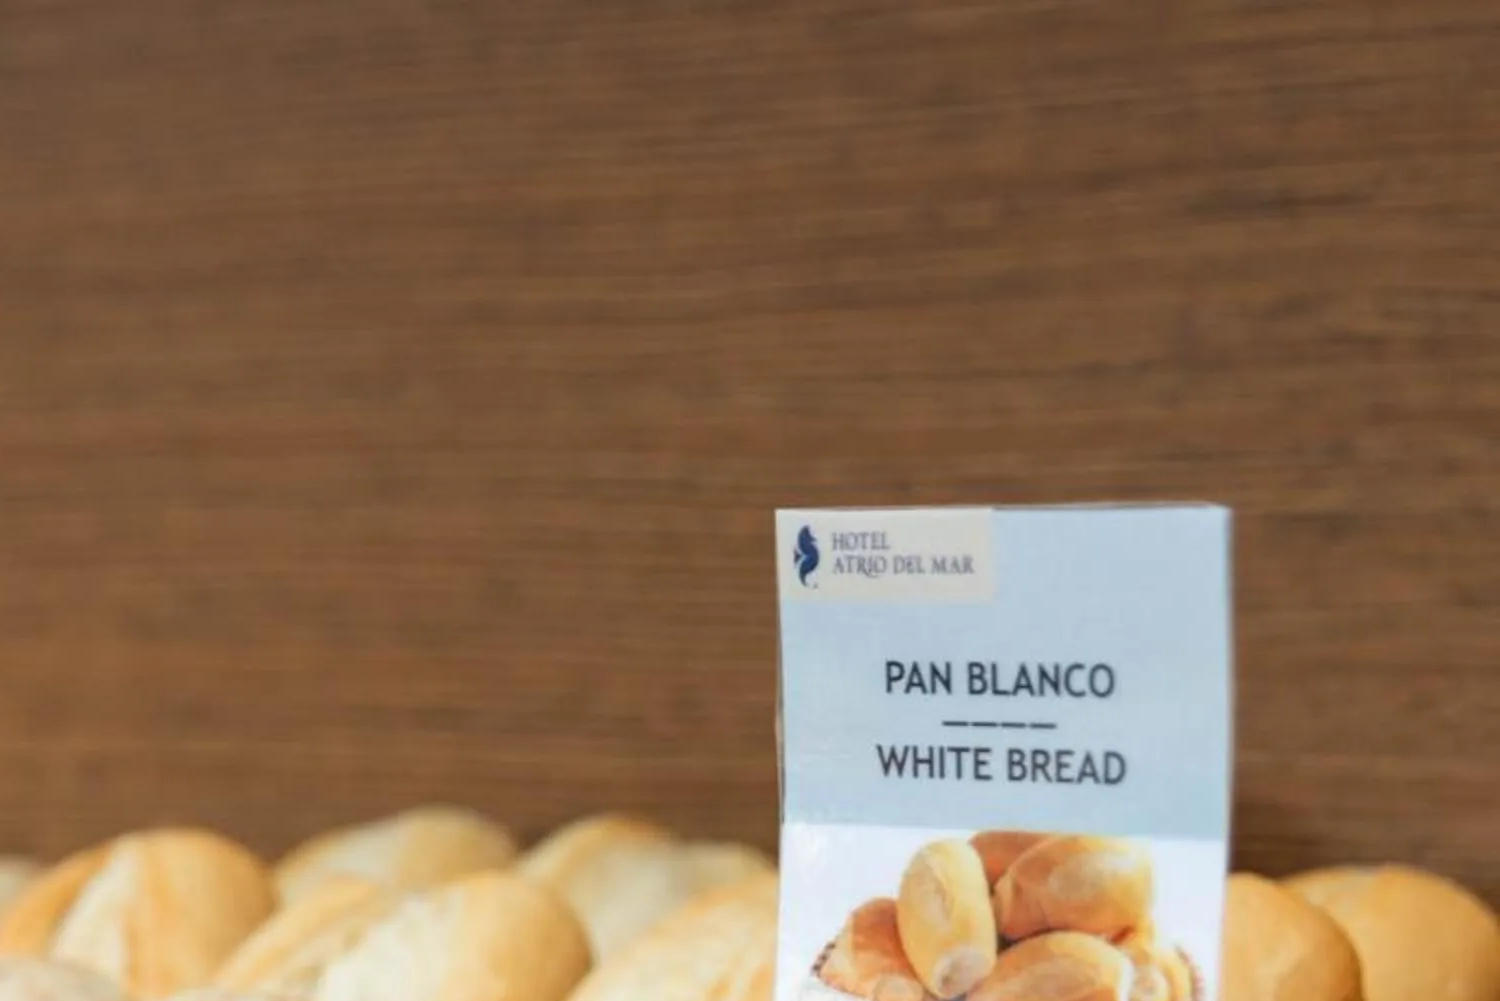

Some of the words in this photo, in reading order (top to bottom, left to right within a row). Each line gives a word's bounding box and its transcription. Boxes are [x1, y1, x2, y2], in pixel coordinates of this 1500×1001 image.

[831, 531, 891, 551] HOTEL
[832, 555, 887, 578] ATRIO
[893, 555, 925, 575] DEL
[931, 555, 975, 575] MAR
[885, 661, 952, 695] PAN
[967, 662, 1116, 698] BLANCO
[876, 744, 993, 781] WHITE
[1007, 749, 1127, 785] BREAD
